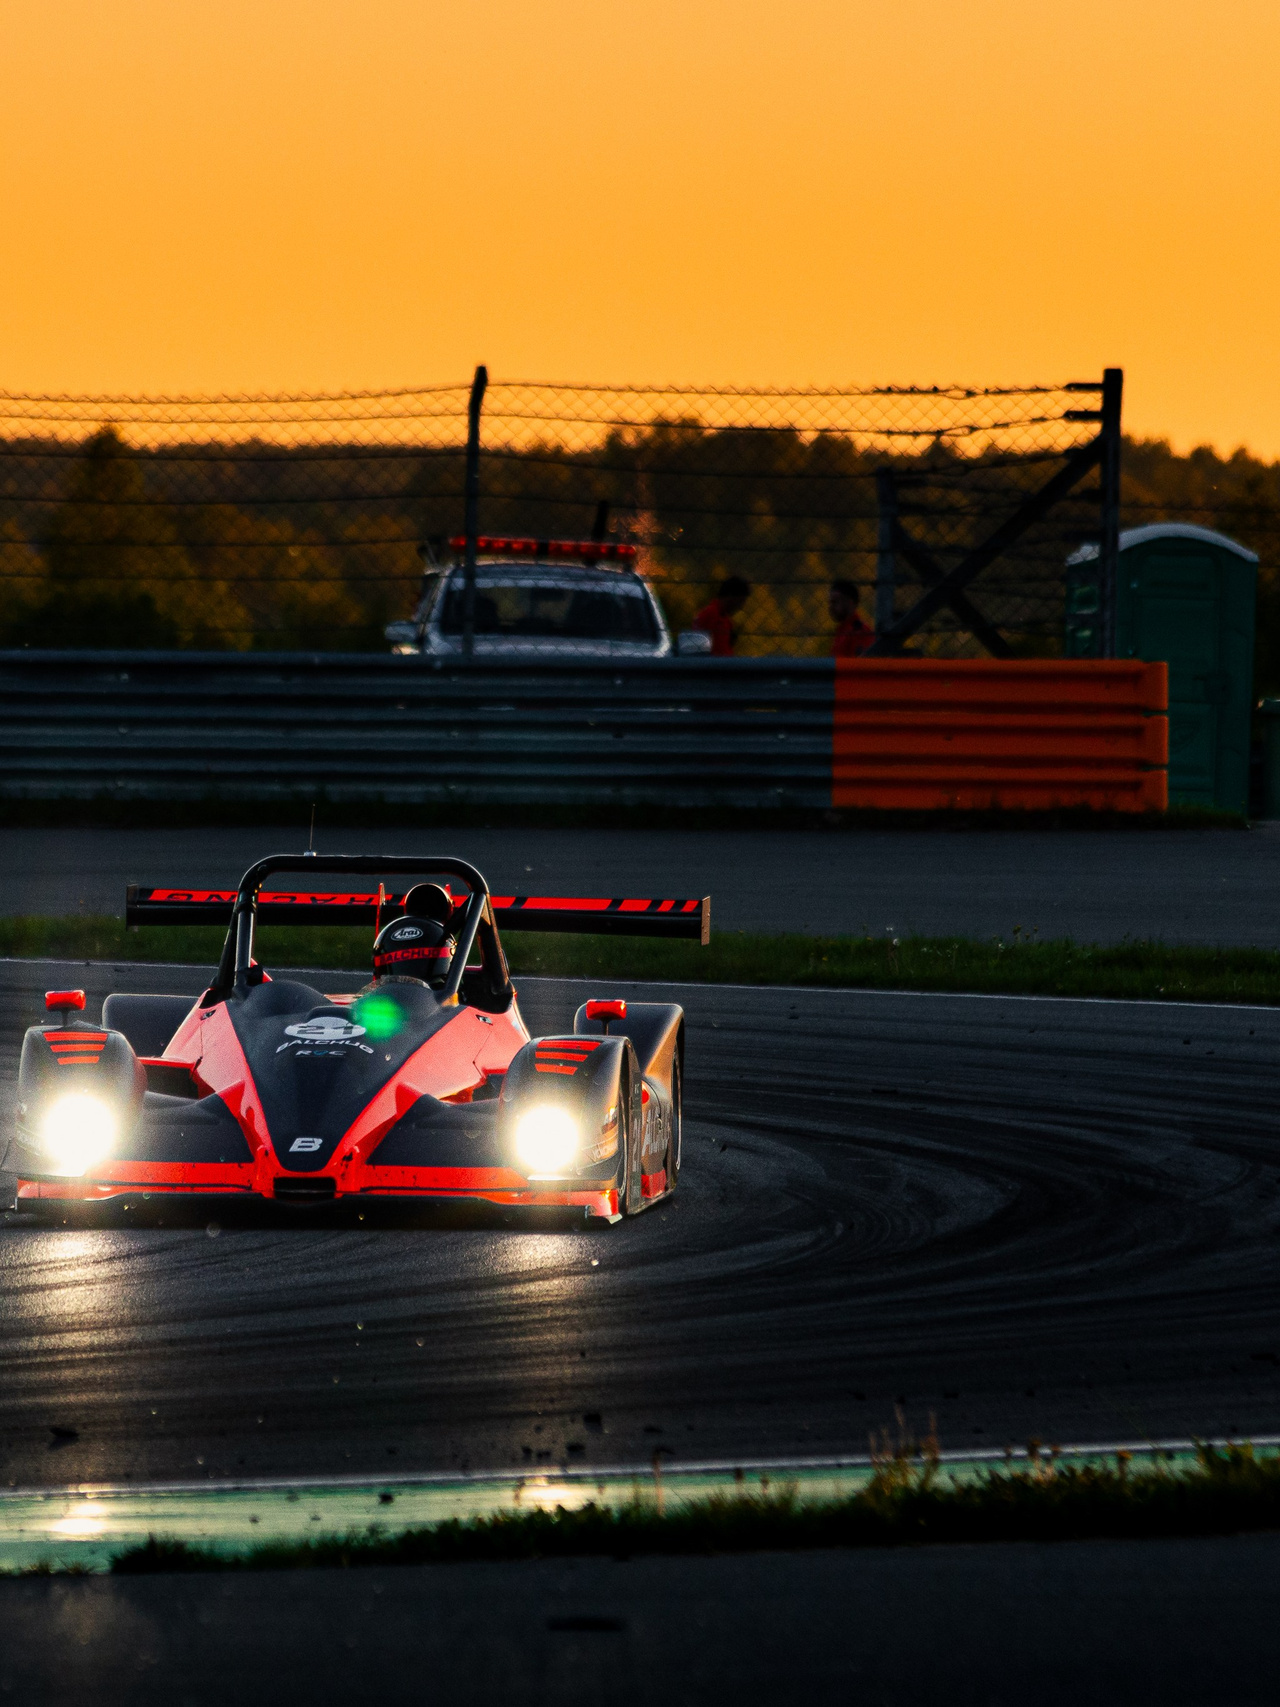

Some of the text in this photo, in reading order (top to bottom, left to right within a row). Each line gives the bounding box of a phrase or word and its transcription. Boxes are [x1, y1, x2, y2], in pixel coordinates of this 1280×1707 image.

[160, 893, 374, 905] RACNG
[275, 1040, 374, 1055] BALCHUG
[289, 1137, 323, 1152] B
